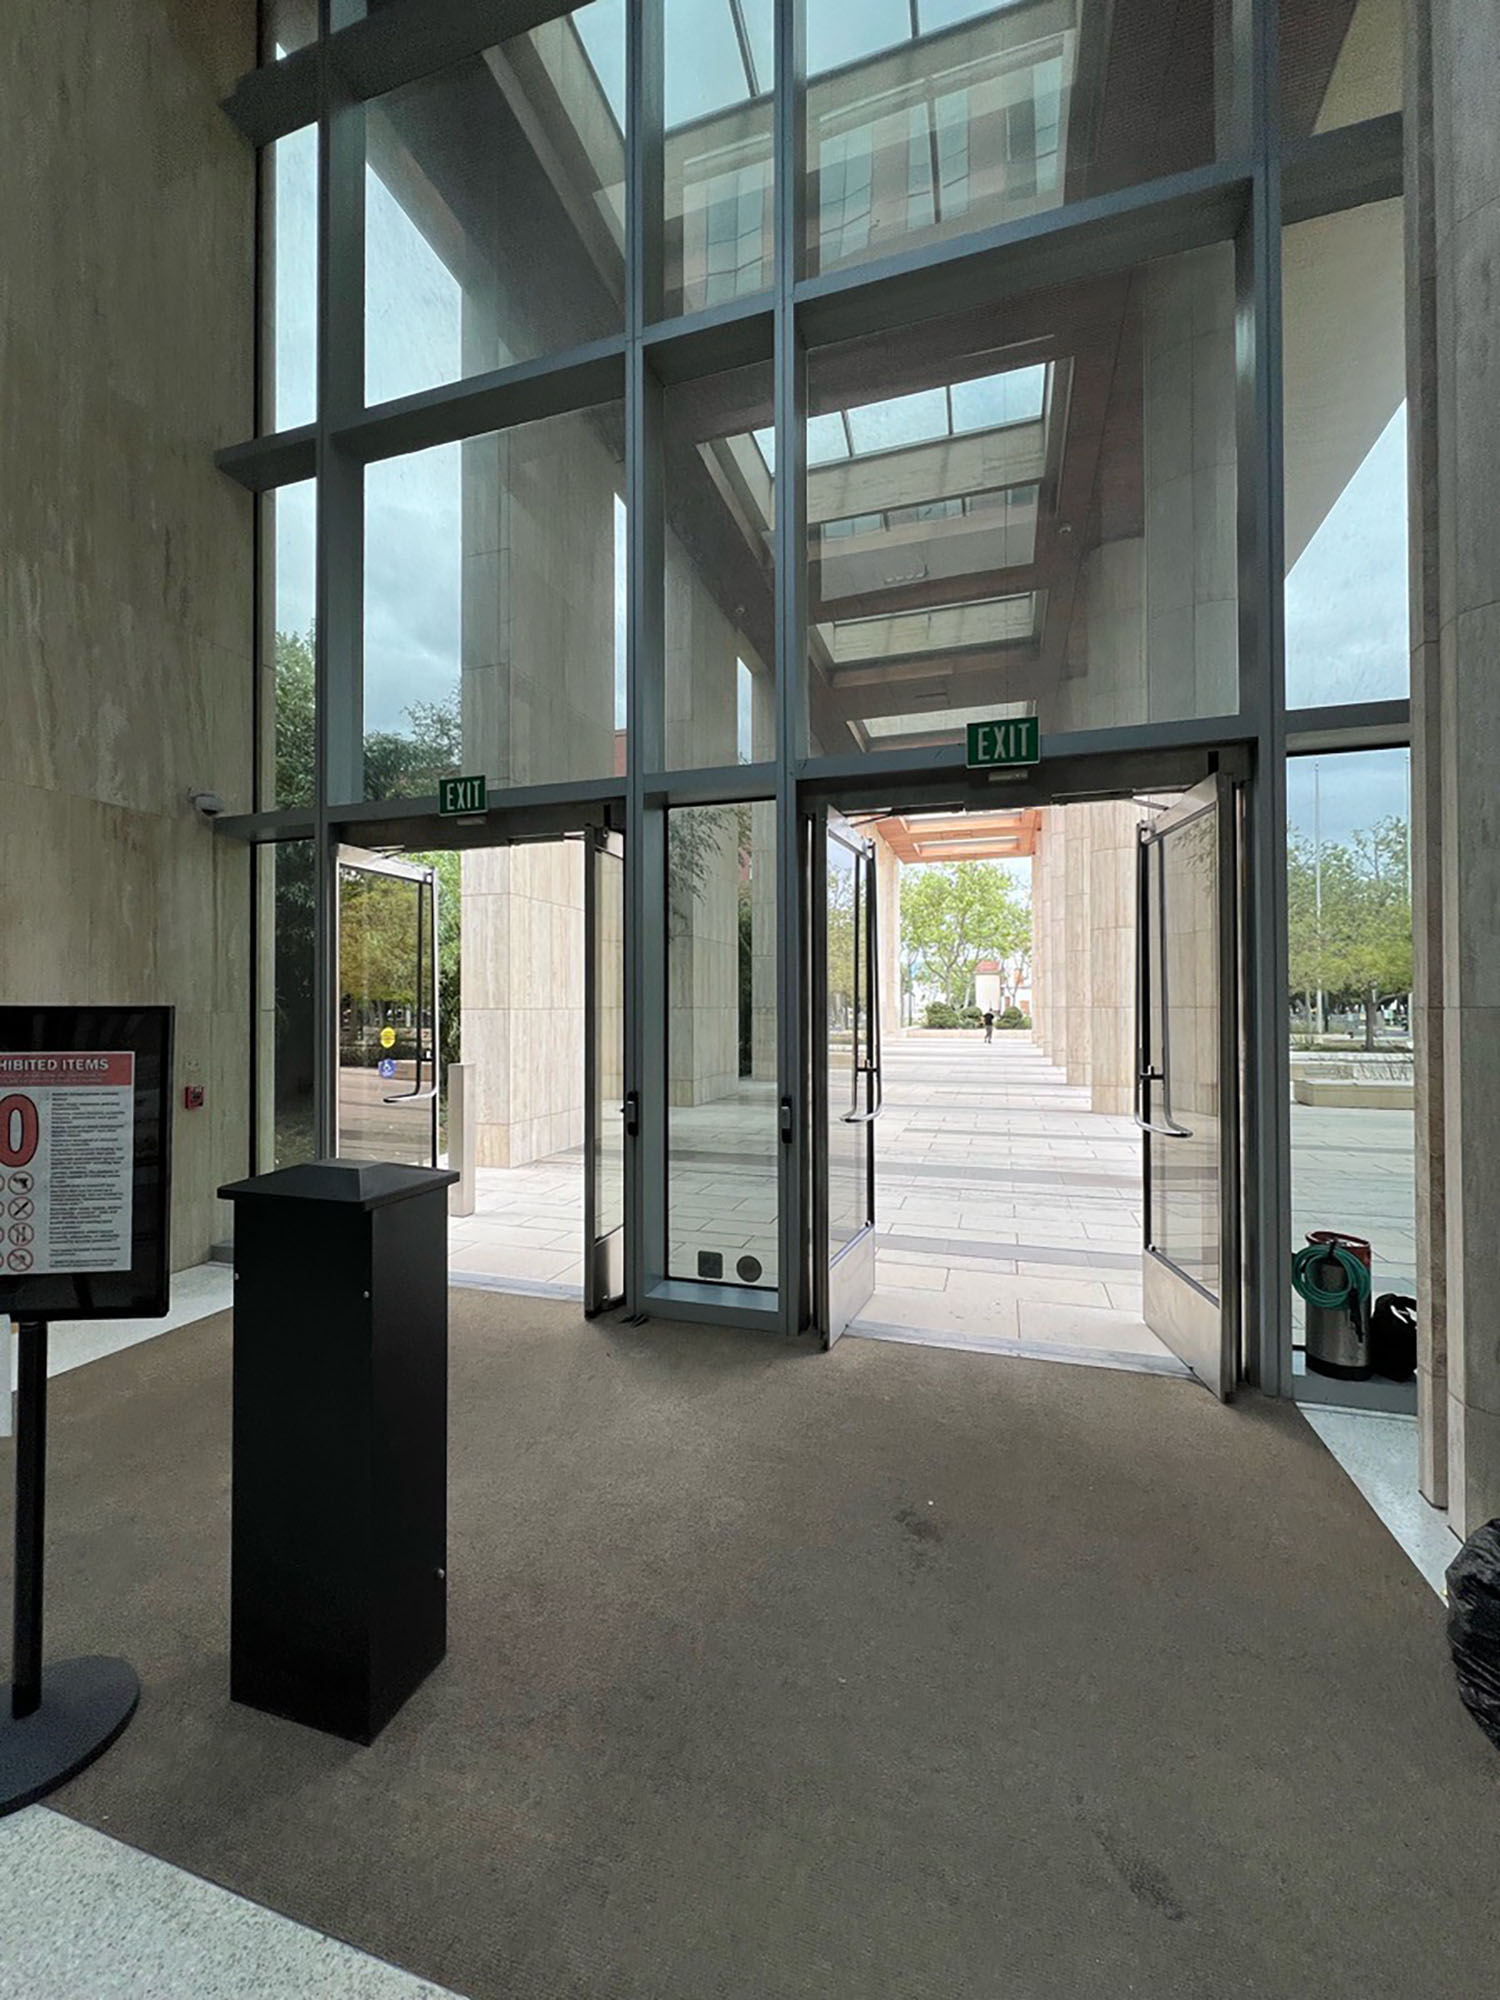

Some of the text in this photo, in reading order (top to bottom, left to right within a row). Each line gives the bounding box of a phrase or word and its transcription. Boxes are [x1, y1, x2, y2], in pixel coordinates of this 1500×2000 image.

[978, 723, 1031, 761] EXIT
[446, 780, 480, 811] EXIT
[62, 1058, 109, 1071] ITEMS
